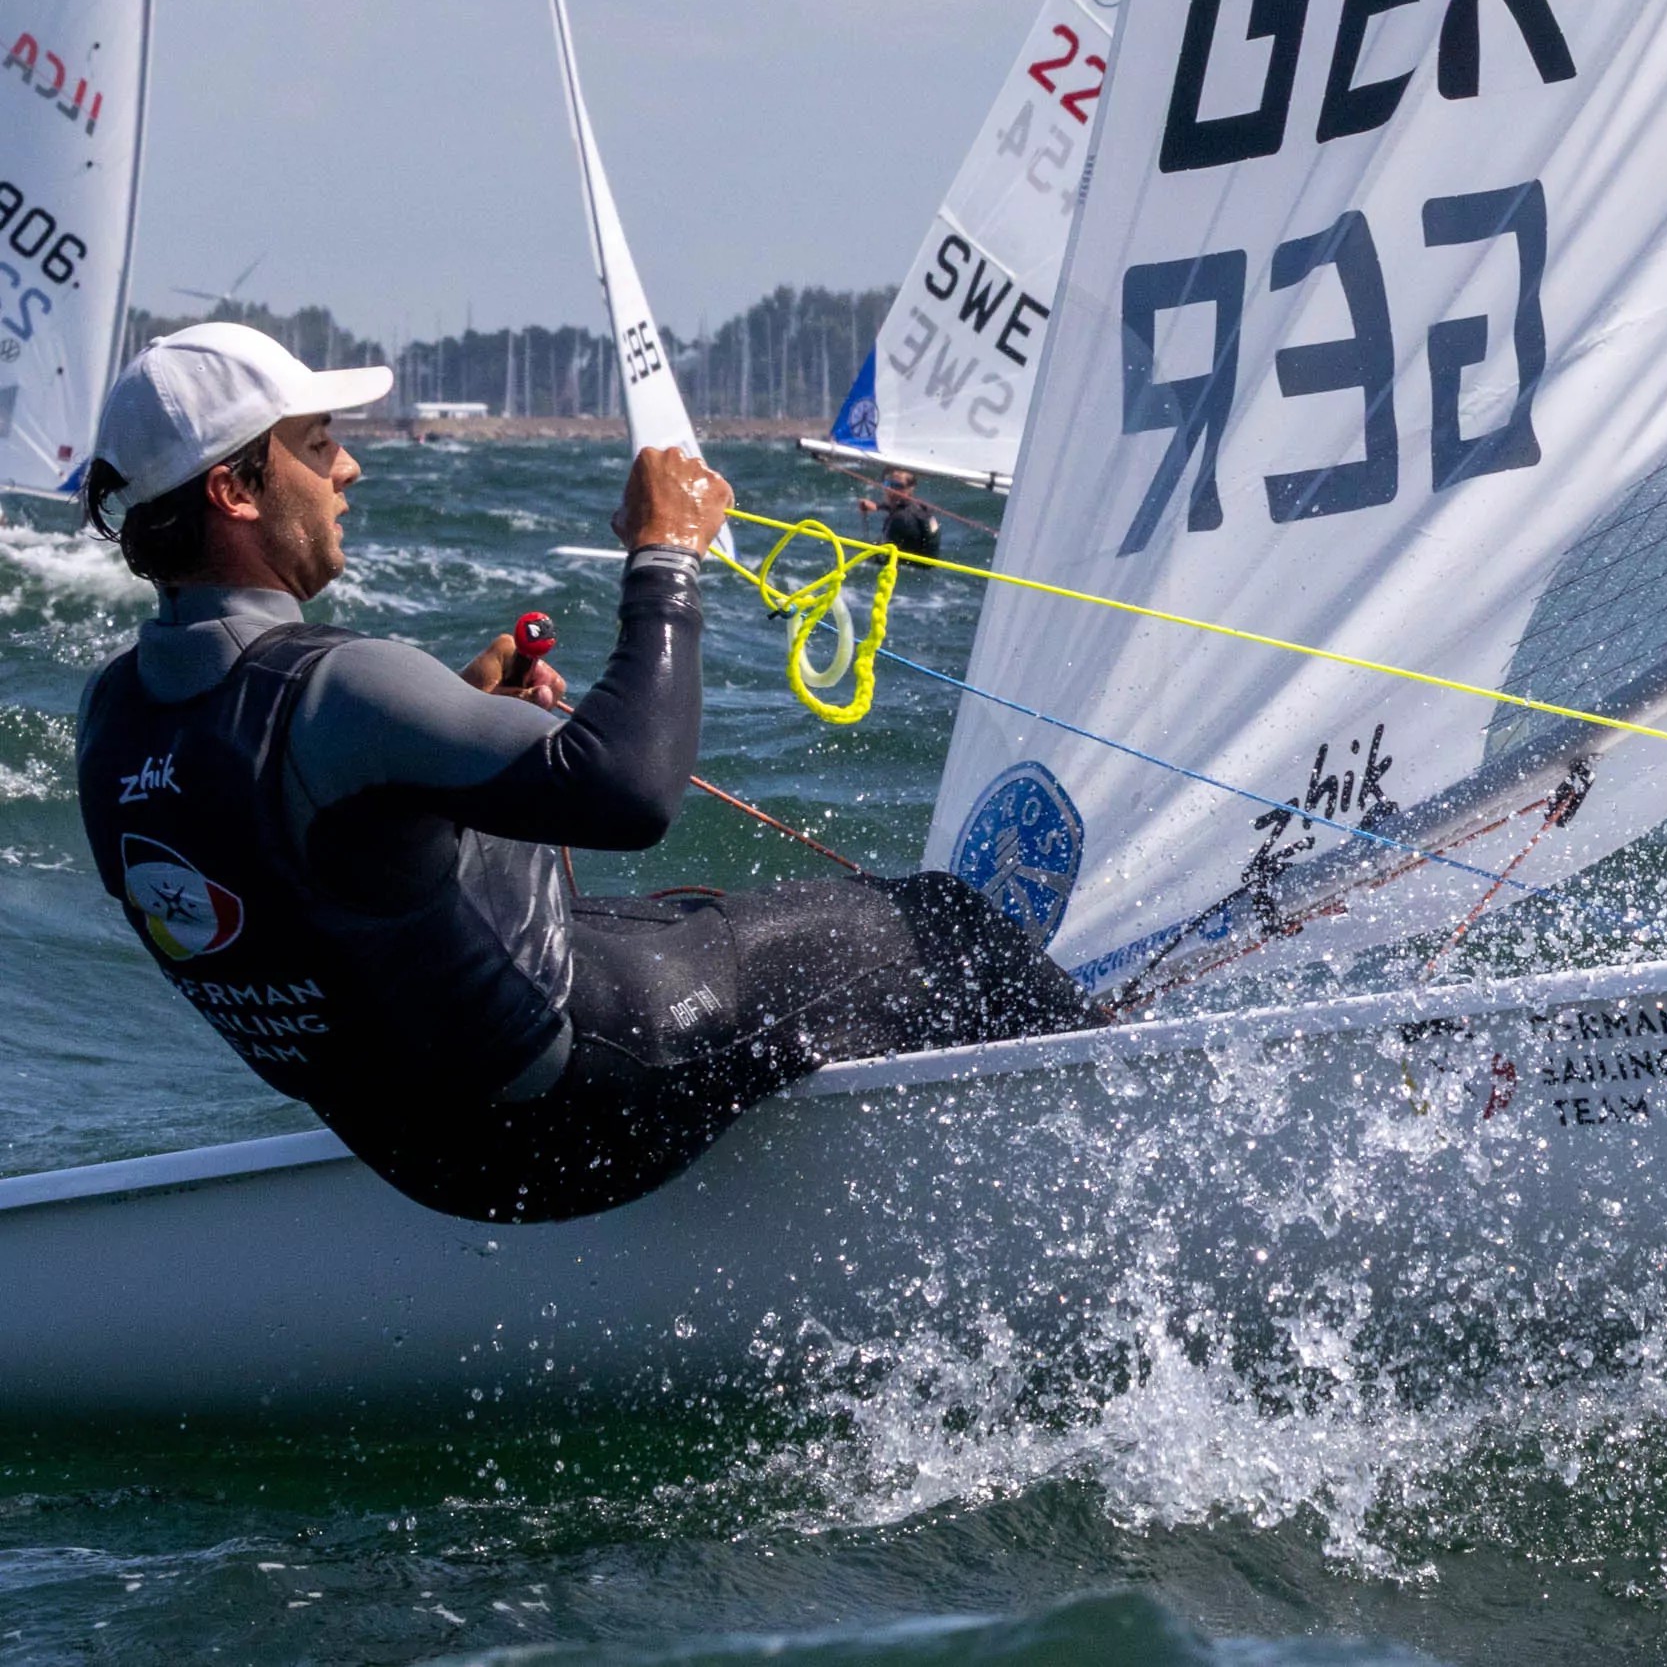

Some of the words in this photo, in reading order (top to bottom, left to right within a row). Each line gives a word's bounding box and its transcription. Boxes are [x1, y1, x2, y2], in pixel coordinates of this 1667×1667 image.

[924, 234, 1051, 368] SWE
[164, 969, 326, 1006] ERMAN
[204, 1010, 330, 1036] AILING
[224, 1035, 309, 1062] EAM
